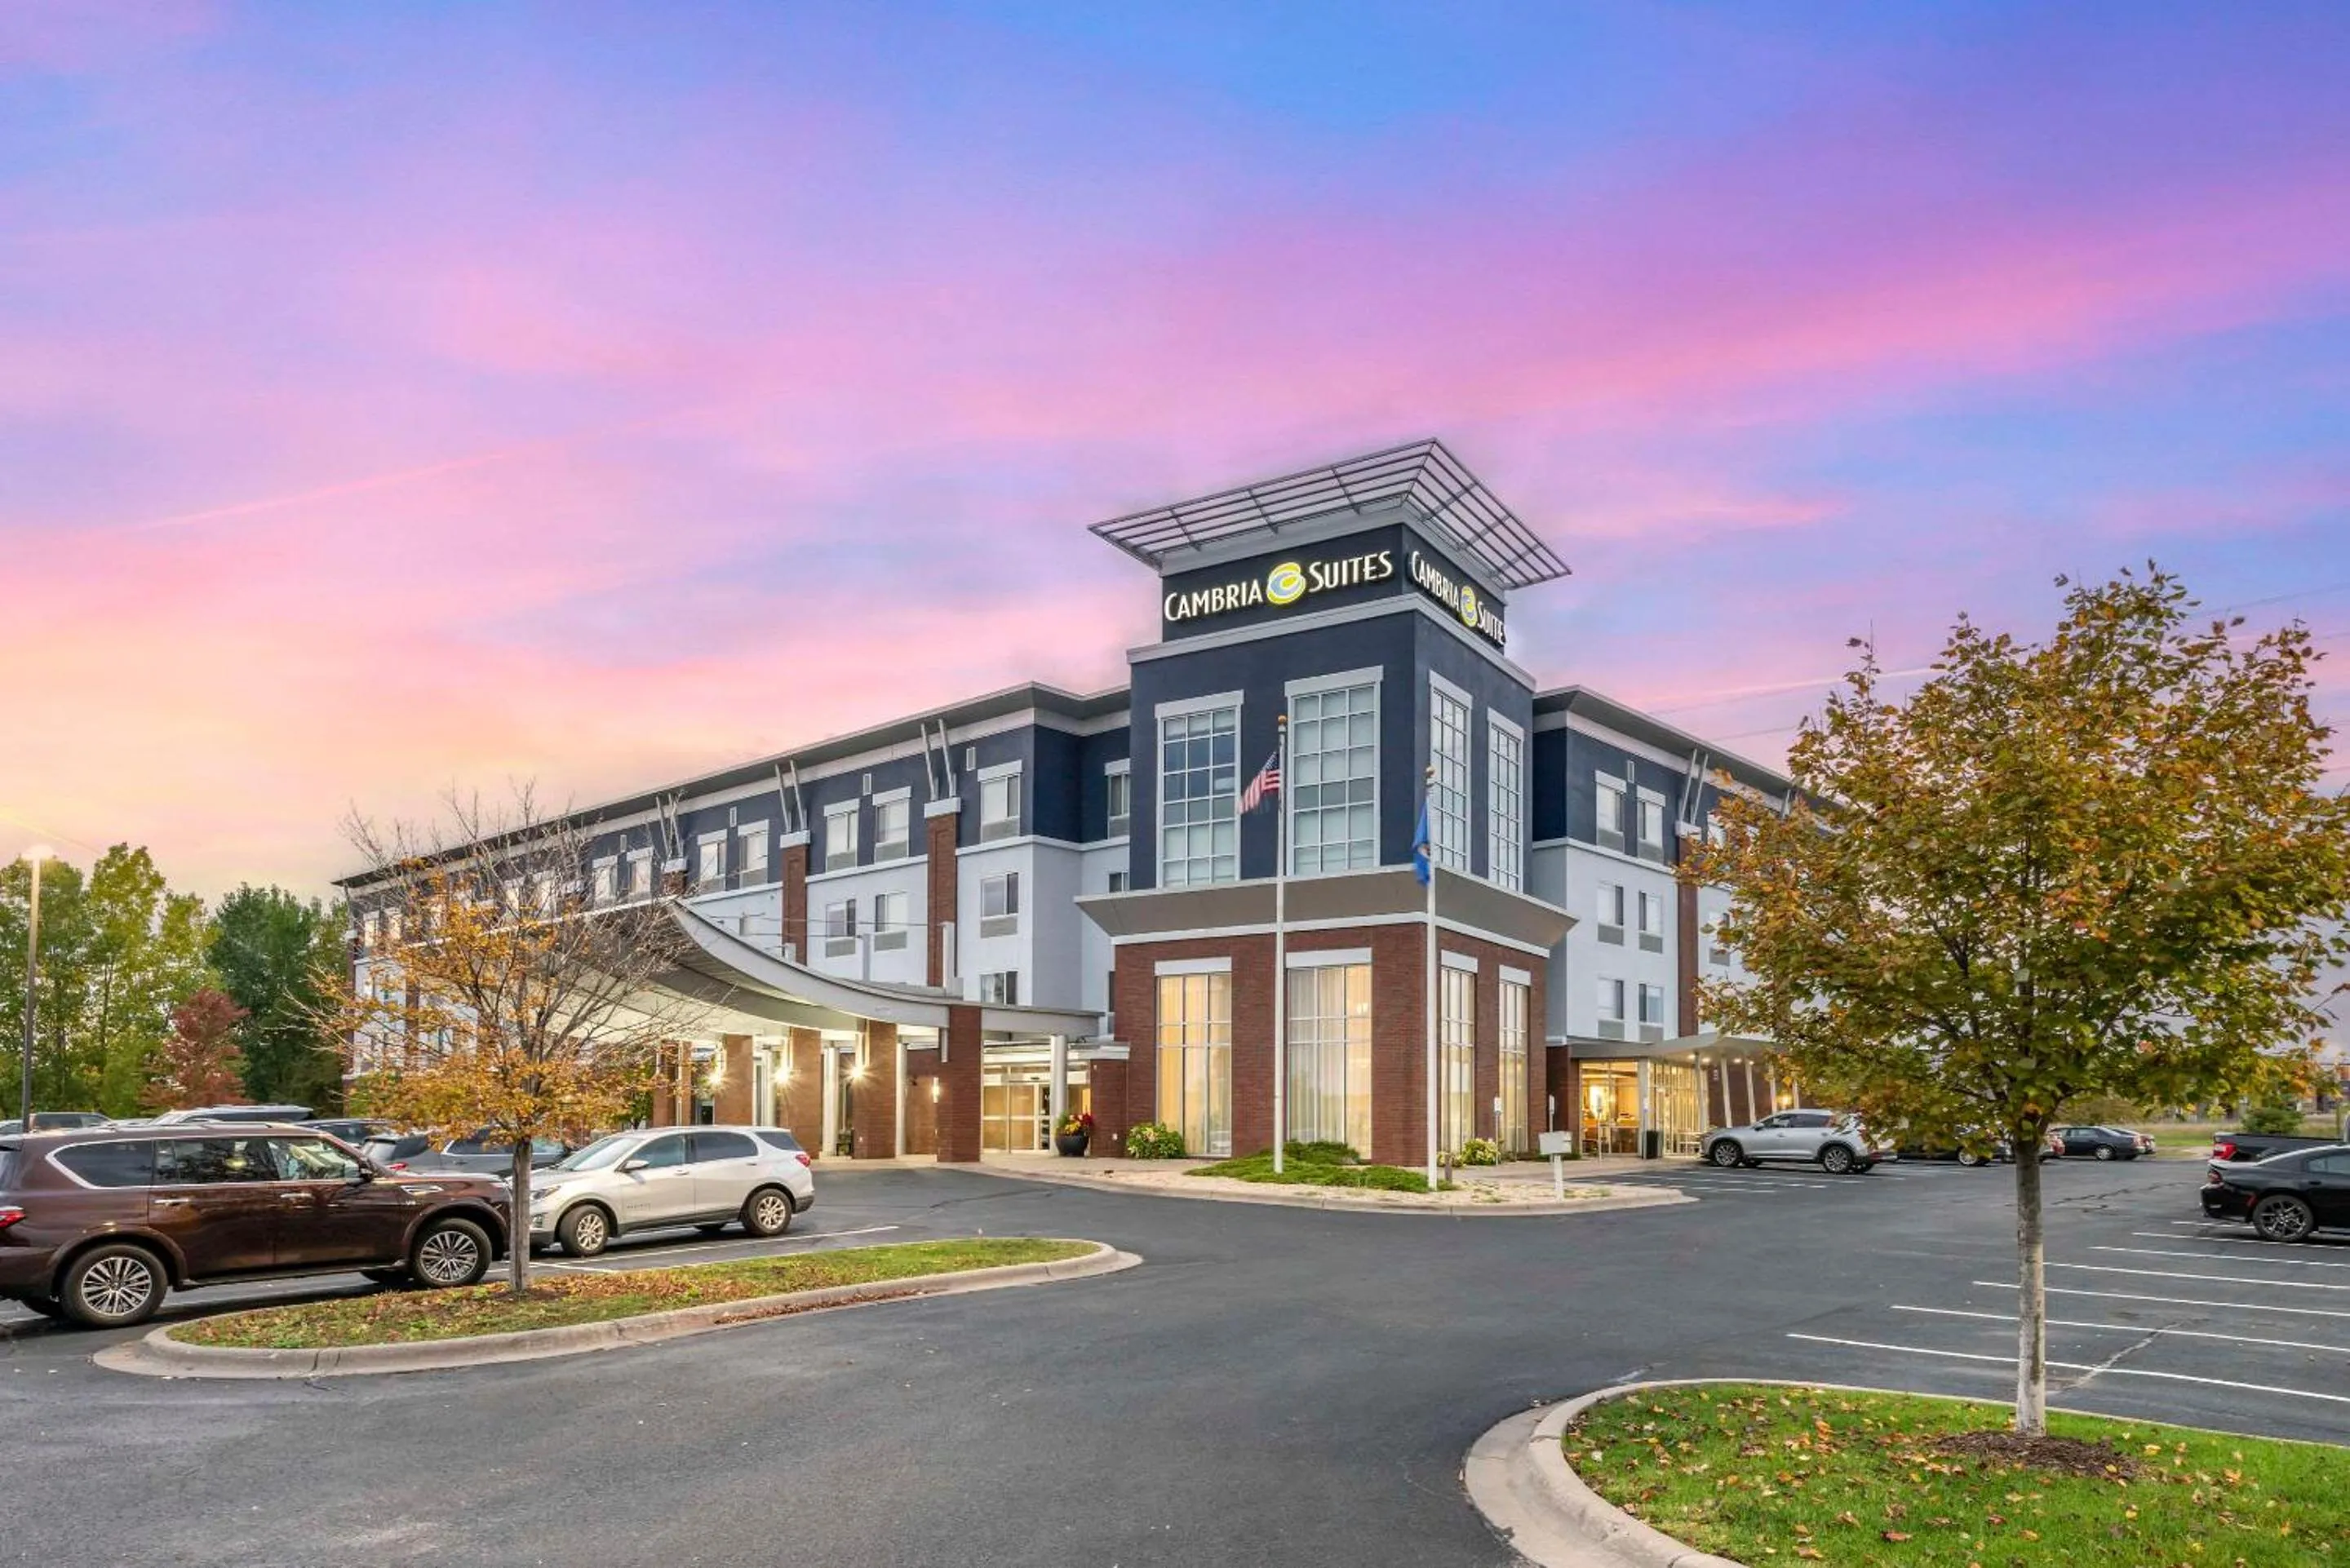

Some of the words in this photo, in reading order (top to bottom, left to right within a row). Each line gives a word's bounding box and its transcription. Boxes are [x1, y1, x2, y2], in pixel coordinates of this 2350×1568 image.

[1164, 579, 1262, 622] CAMBRIA
[1308, 551, 1394, 593] SUITES
[1412, 551, 1459, 611] CAMBRIA
